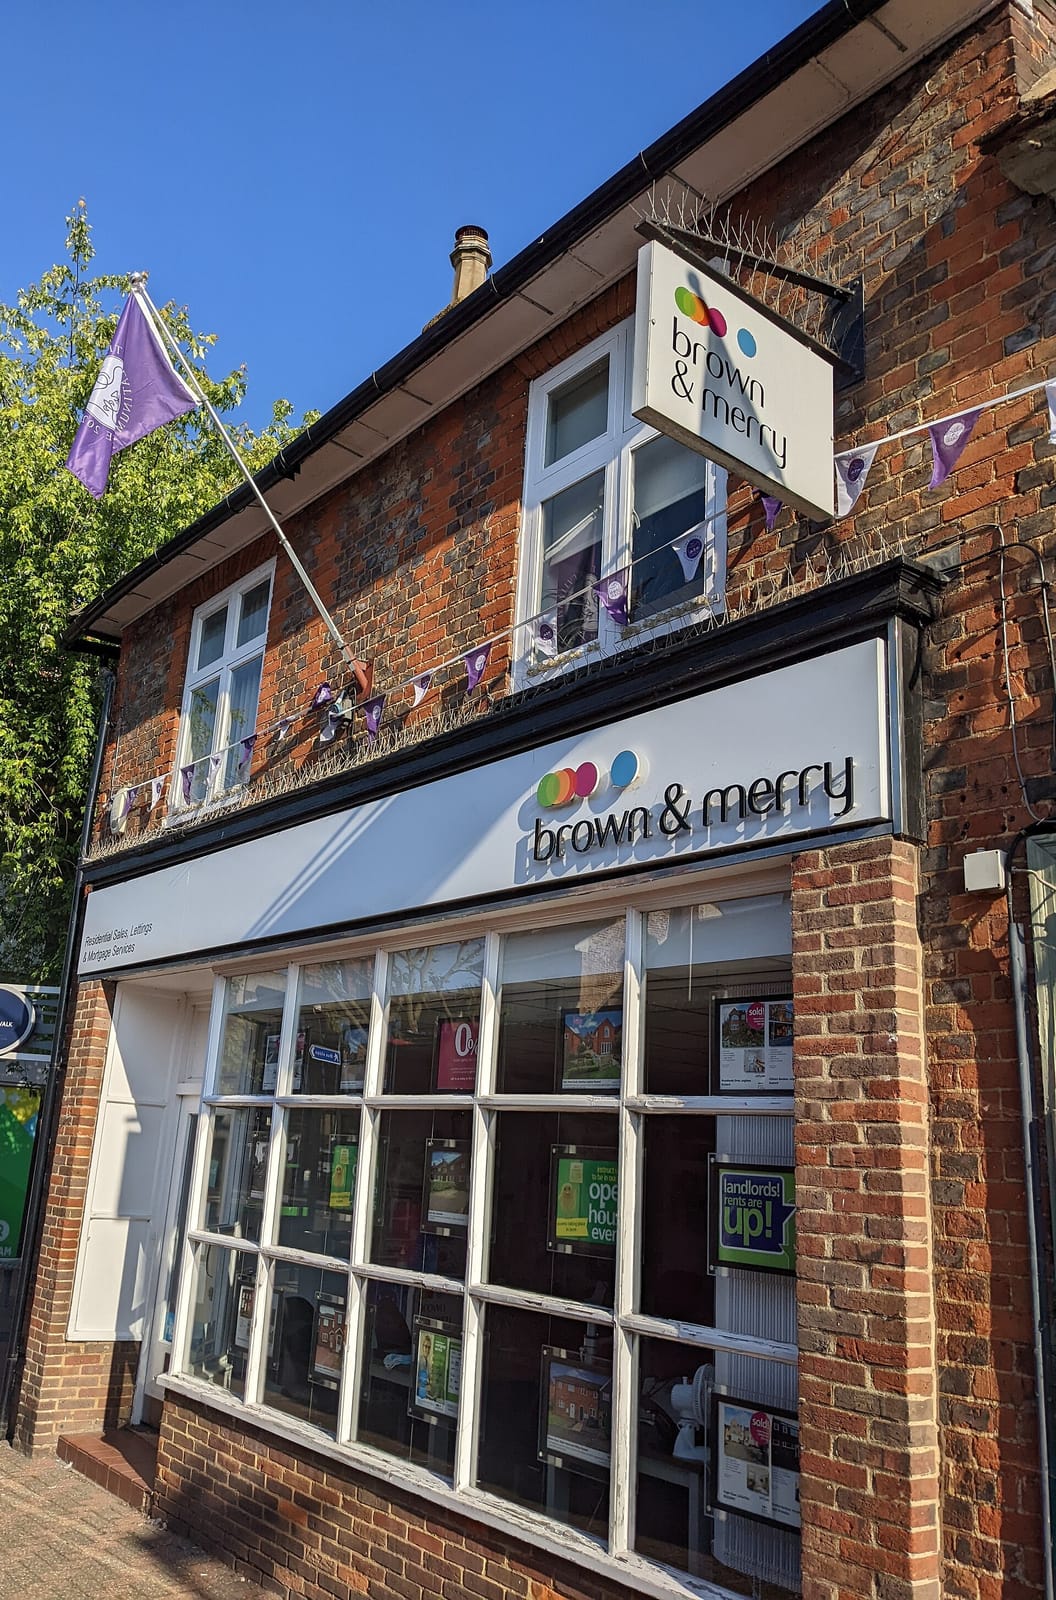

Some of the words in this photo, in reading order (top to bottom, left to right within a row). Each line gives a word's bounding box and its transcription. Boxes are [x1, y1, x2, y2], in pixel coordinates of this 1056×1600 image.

[672, 316, 766, 408] brown
[671, 359, 694, 404] &
[702, 386, 787, 469] merry
[533, 805, 649, 861] brown
[660, 782, 692, 835] &
[702, 756, 853, 827] merry
[85, 930, 113, 947] Residential
[113, 928, 129, 940] Sales,
[130, 922, 153, 936] Lettings
[82, 952, 87, 963] &
[88, 947, 111, 963] Mortgage
[112, 943, 136, 957] Services
[749, 1006, 765, 1017] sold!
[724, 1178, 780, 1198] landlords!
[724, 1196, 746, 1207] rents
[747, 1199, 763, 1208] are
[724, 1200, 772, 1246] up!
[752, 1418, 770, 1429] sold!
